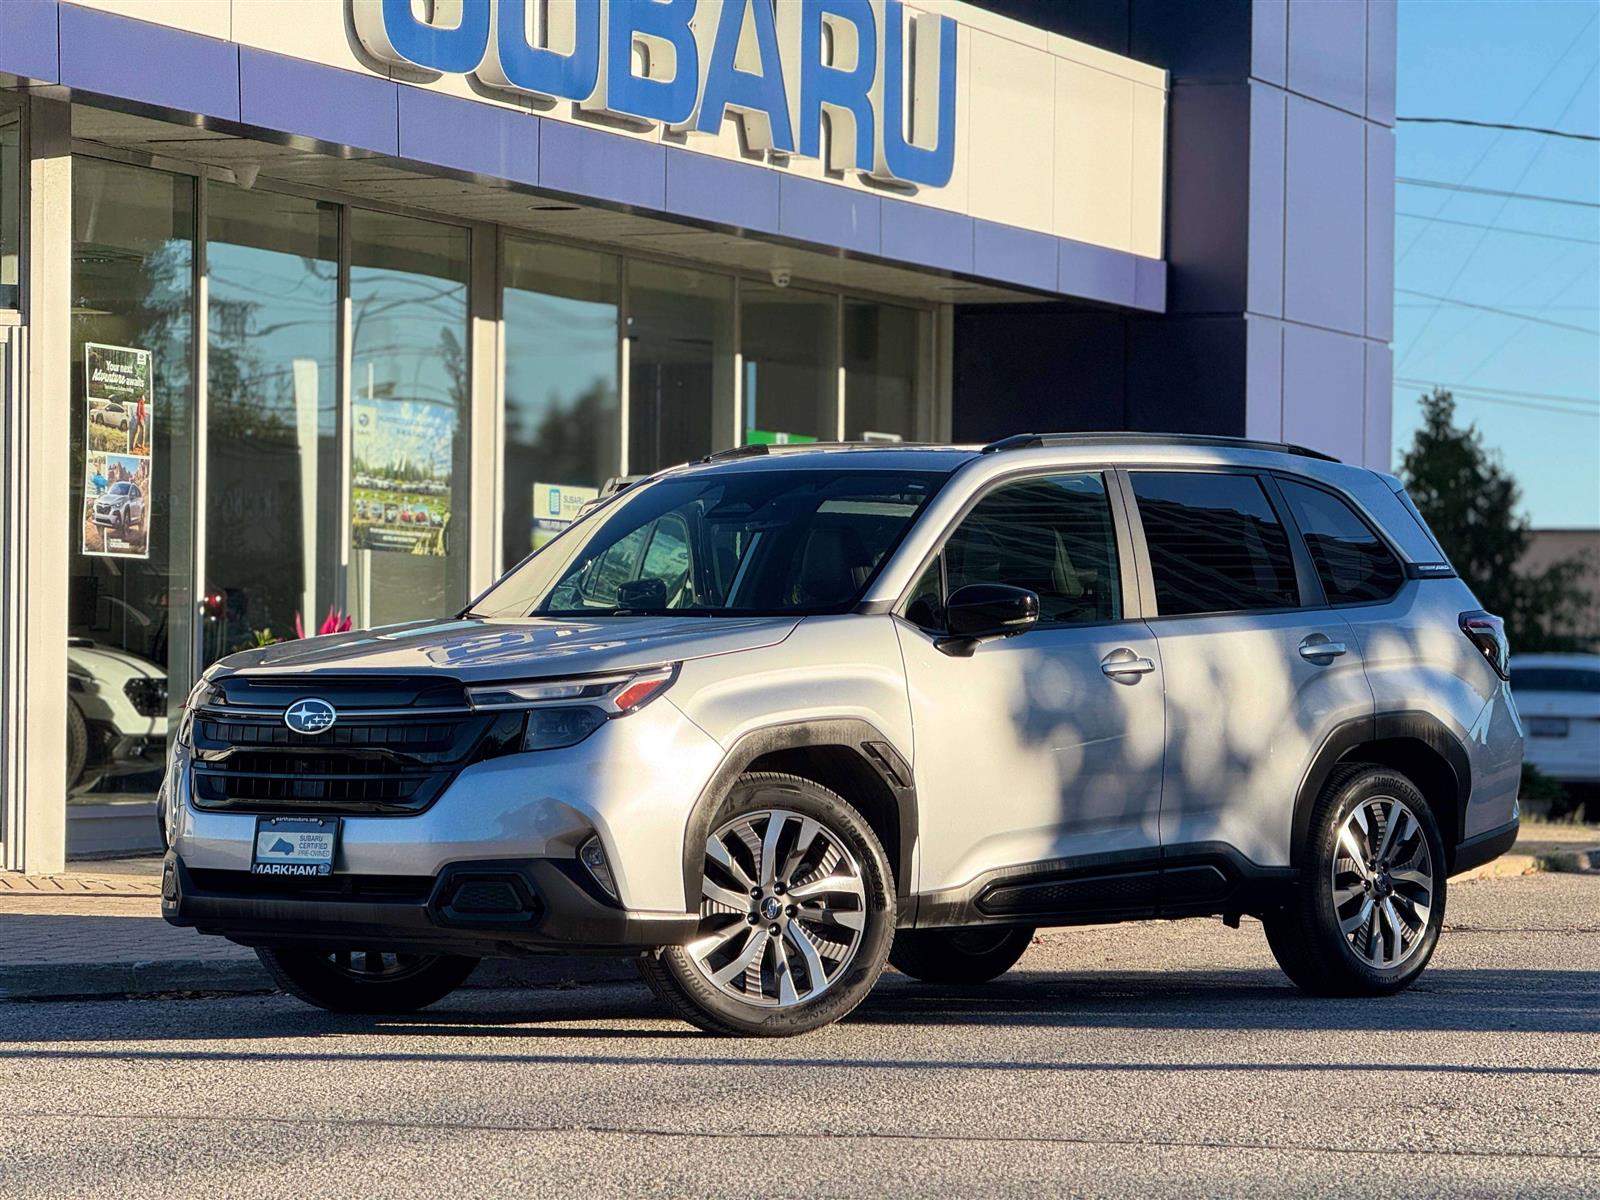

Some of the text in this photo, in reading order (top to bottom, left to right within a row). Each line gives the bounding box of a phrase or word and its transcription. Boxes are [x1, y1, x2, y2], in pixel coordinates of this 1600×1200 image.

[299, 834, 323, 842] SUBARU
[299, 842, 328, 850] CERTIFIED
[251, 864, 317, 876] MARKHAM
